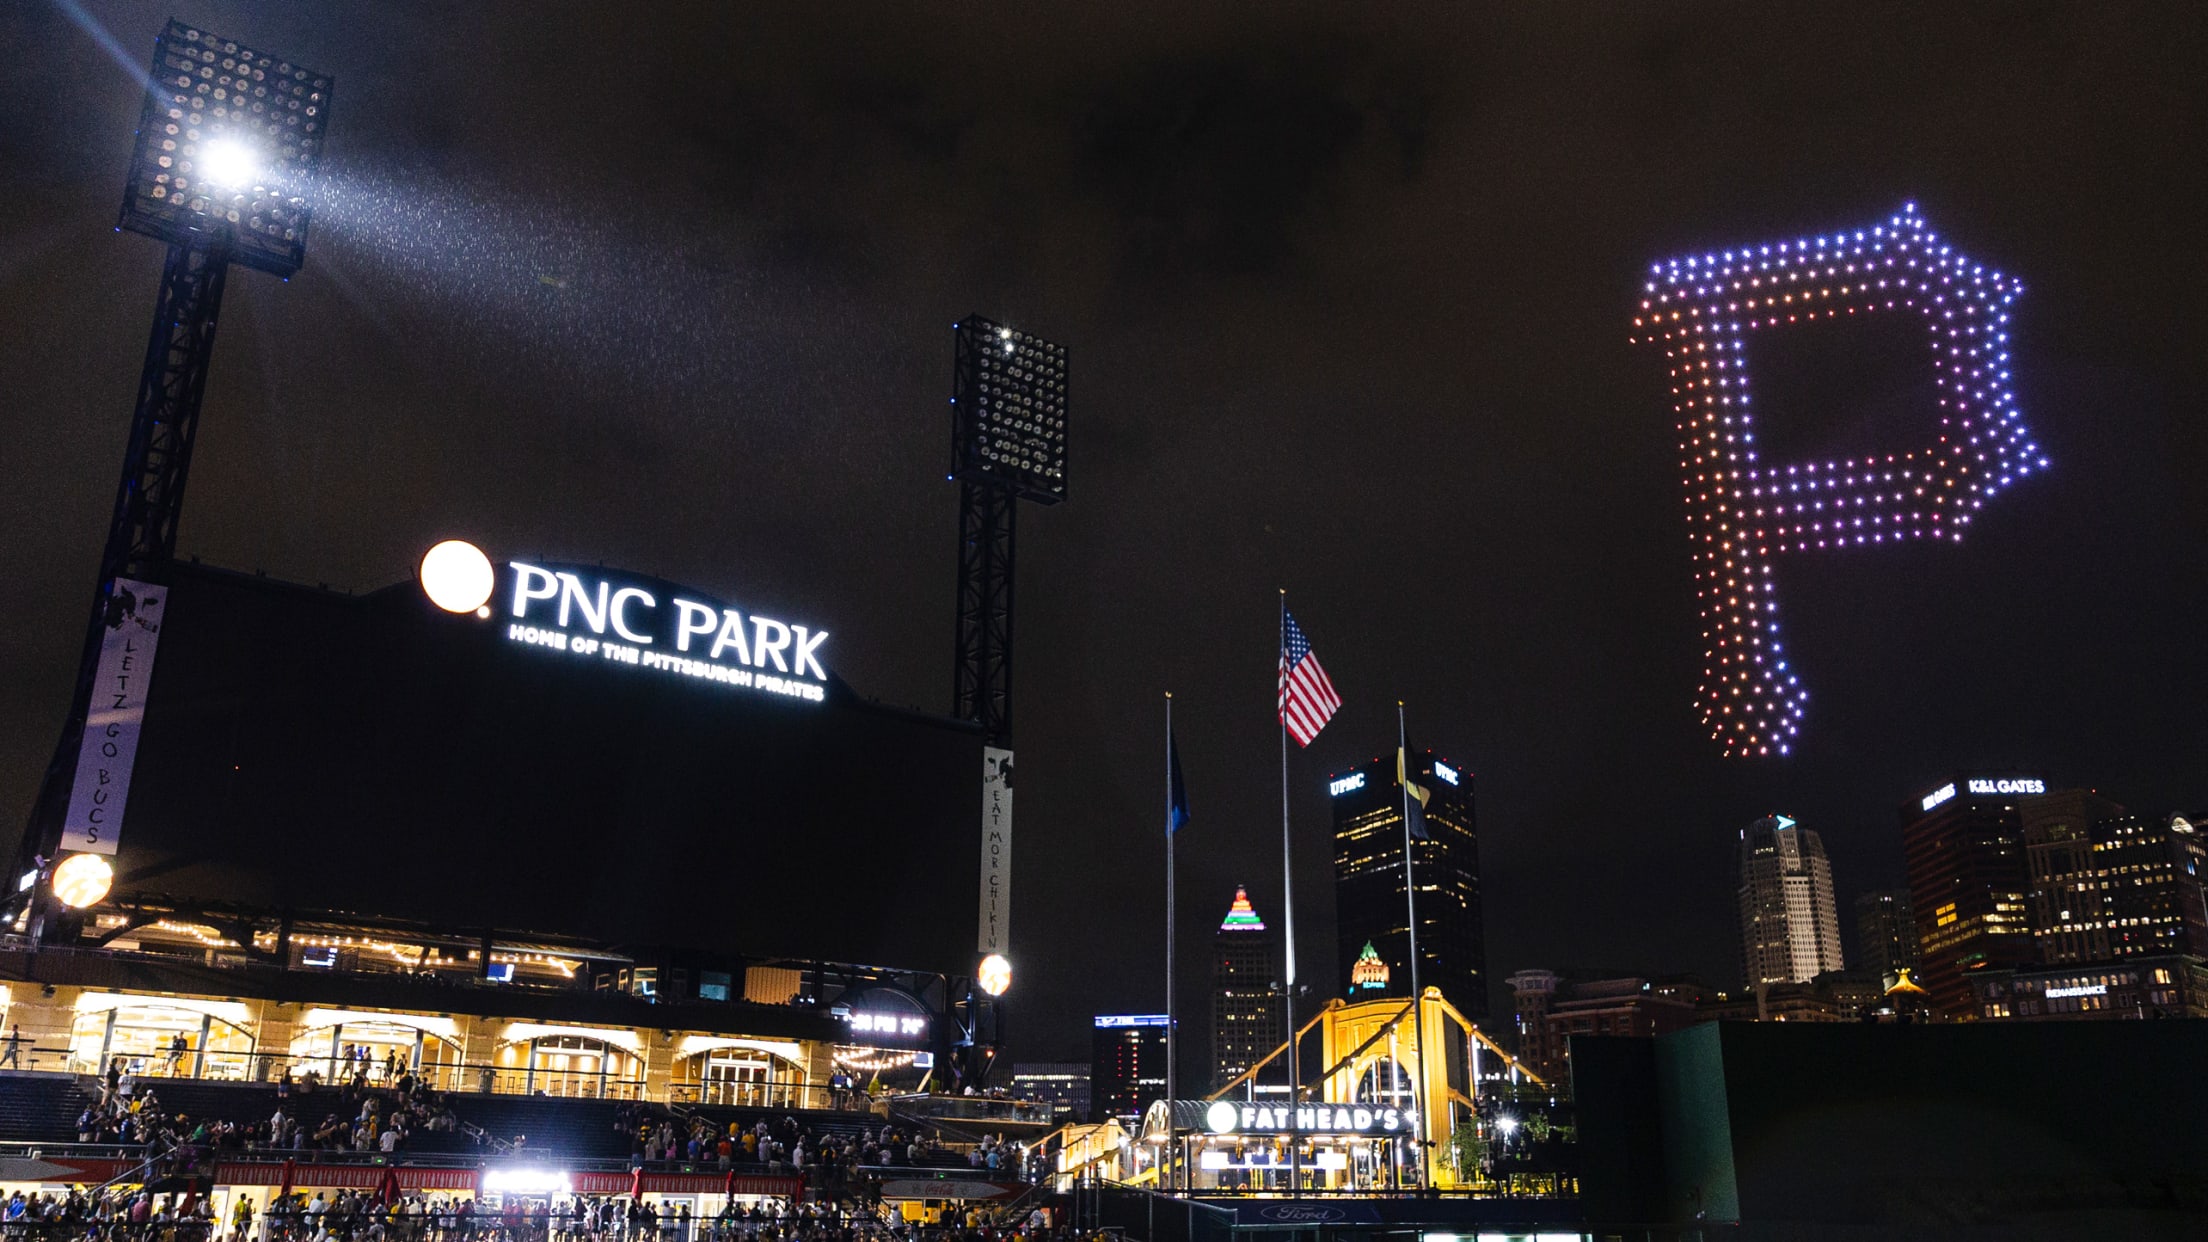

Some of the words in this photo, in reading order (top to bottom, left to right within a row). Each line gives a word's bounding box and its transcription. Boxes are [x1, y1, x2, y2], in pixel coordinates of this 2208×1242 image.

[509, 561, 656, 643] PNC
[673, 598, 829, 681] PARK
[112, 638, 138, 711] LETZ
[509, 624, 567, 650] HOME
[571, 636, 599, 655] OF
[601, 642, 639, 665] THE
[642, 650, 752, 688] PITTSBURGH
[754, 674, 825, 702] PIRATES
[102, 722, 120, 758] GO
[1329, 773, 1365, 796] UPMC
[1968, 780, 1997, 793] K&L
[1997, 780, 2045, 793] GATES
[87, 768, 110, 845] BUCS
[990, 789, 1002, 826] EAT
[989, 831, 1003, 869] MOR
[988, 874, 999, 949] CHIKIN
[1241, 1107, 1289, 1129] FAT
[1296, 1108, 1399, 1130] HEAD'S
[1276, 1206, 1330, 1220] Ford
